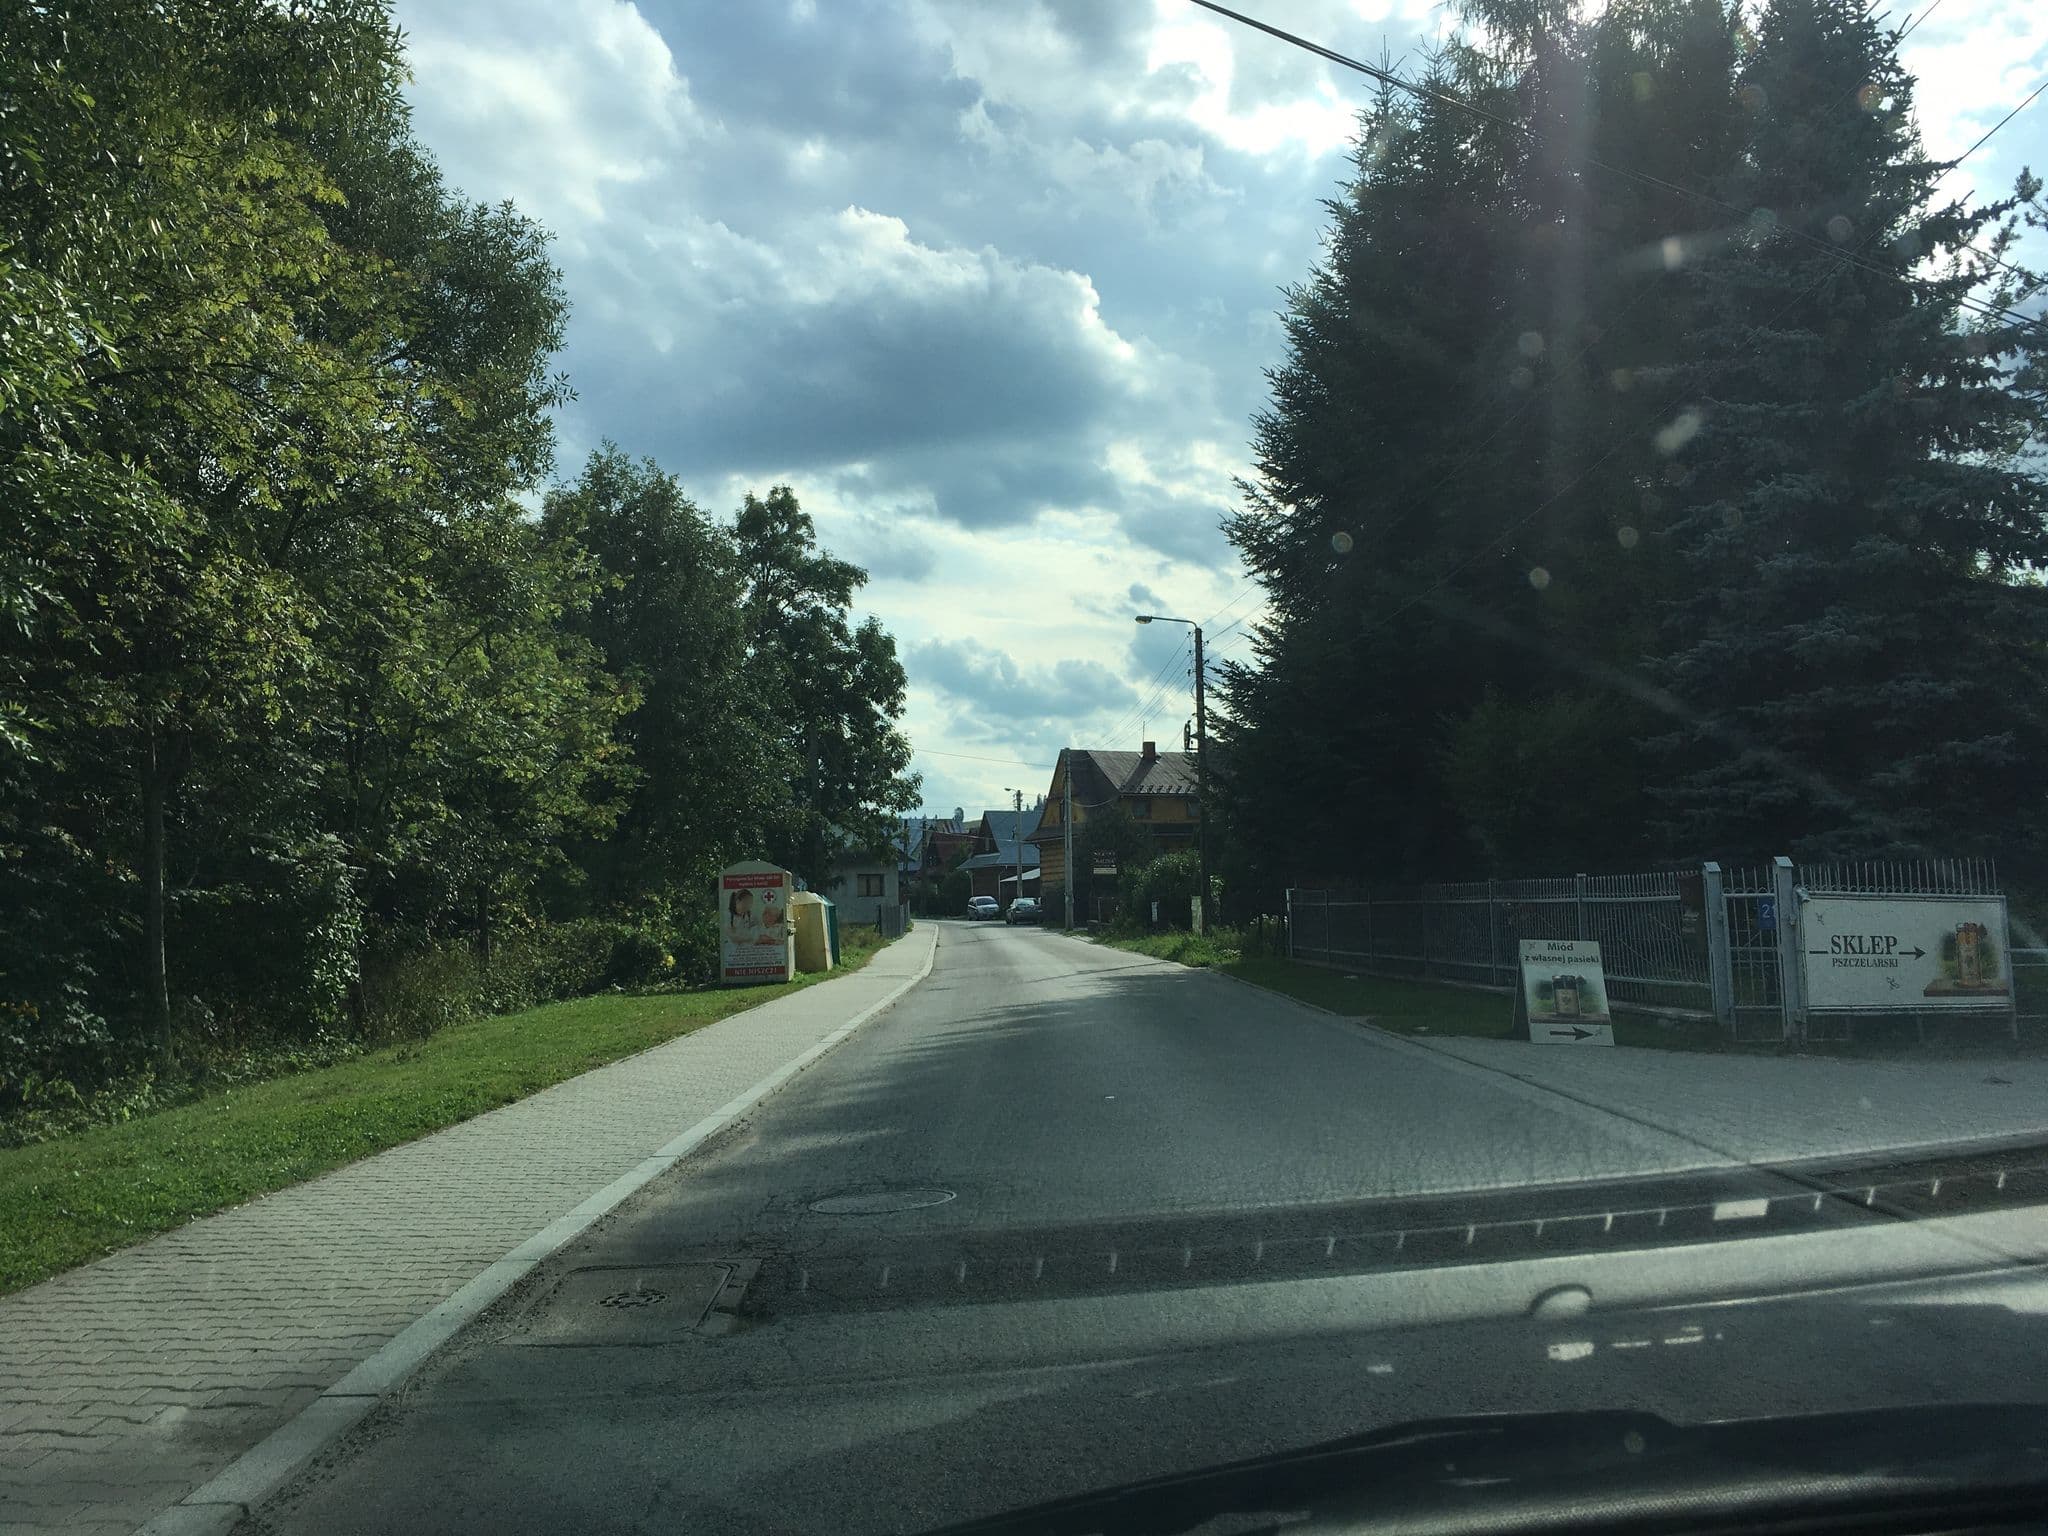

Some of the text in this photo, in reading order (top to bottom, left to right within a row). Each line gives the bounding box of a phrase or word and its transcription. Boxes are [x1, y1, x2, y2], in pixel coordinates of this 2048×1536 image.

[1547, 942, 1575, 951] Miód
[1830, 934, 1898, 955] SKLEP
[1531, 953, 1566, 964] własnej
[1568, 954, 1600, 964] pasieki
[1831, 957, 1899, 968] PSZCZELARSKI
